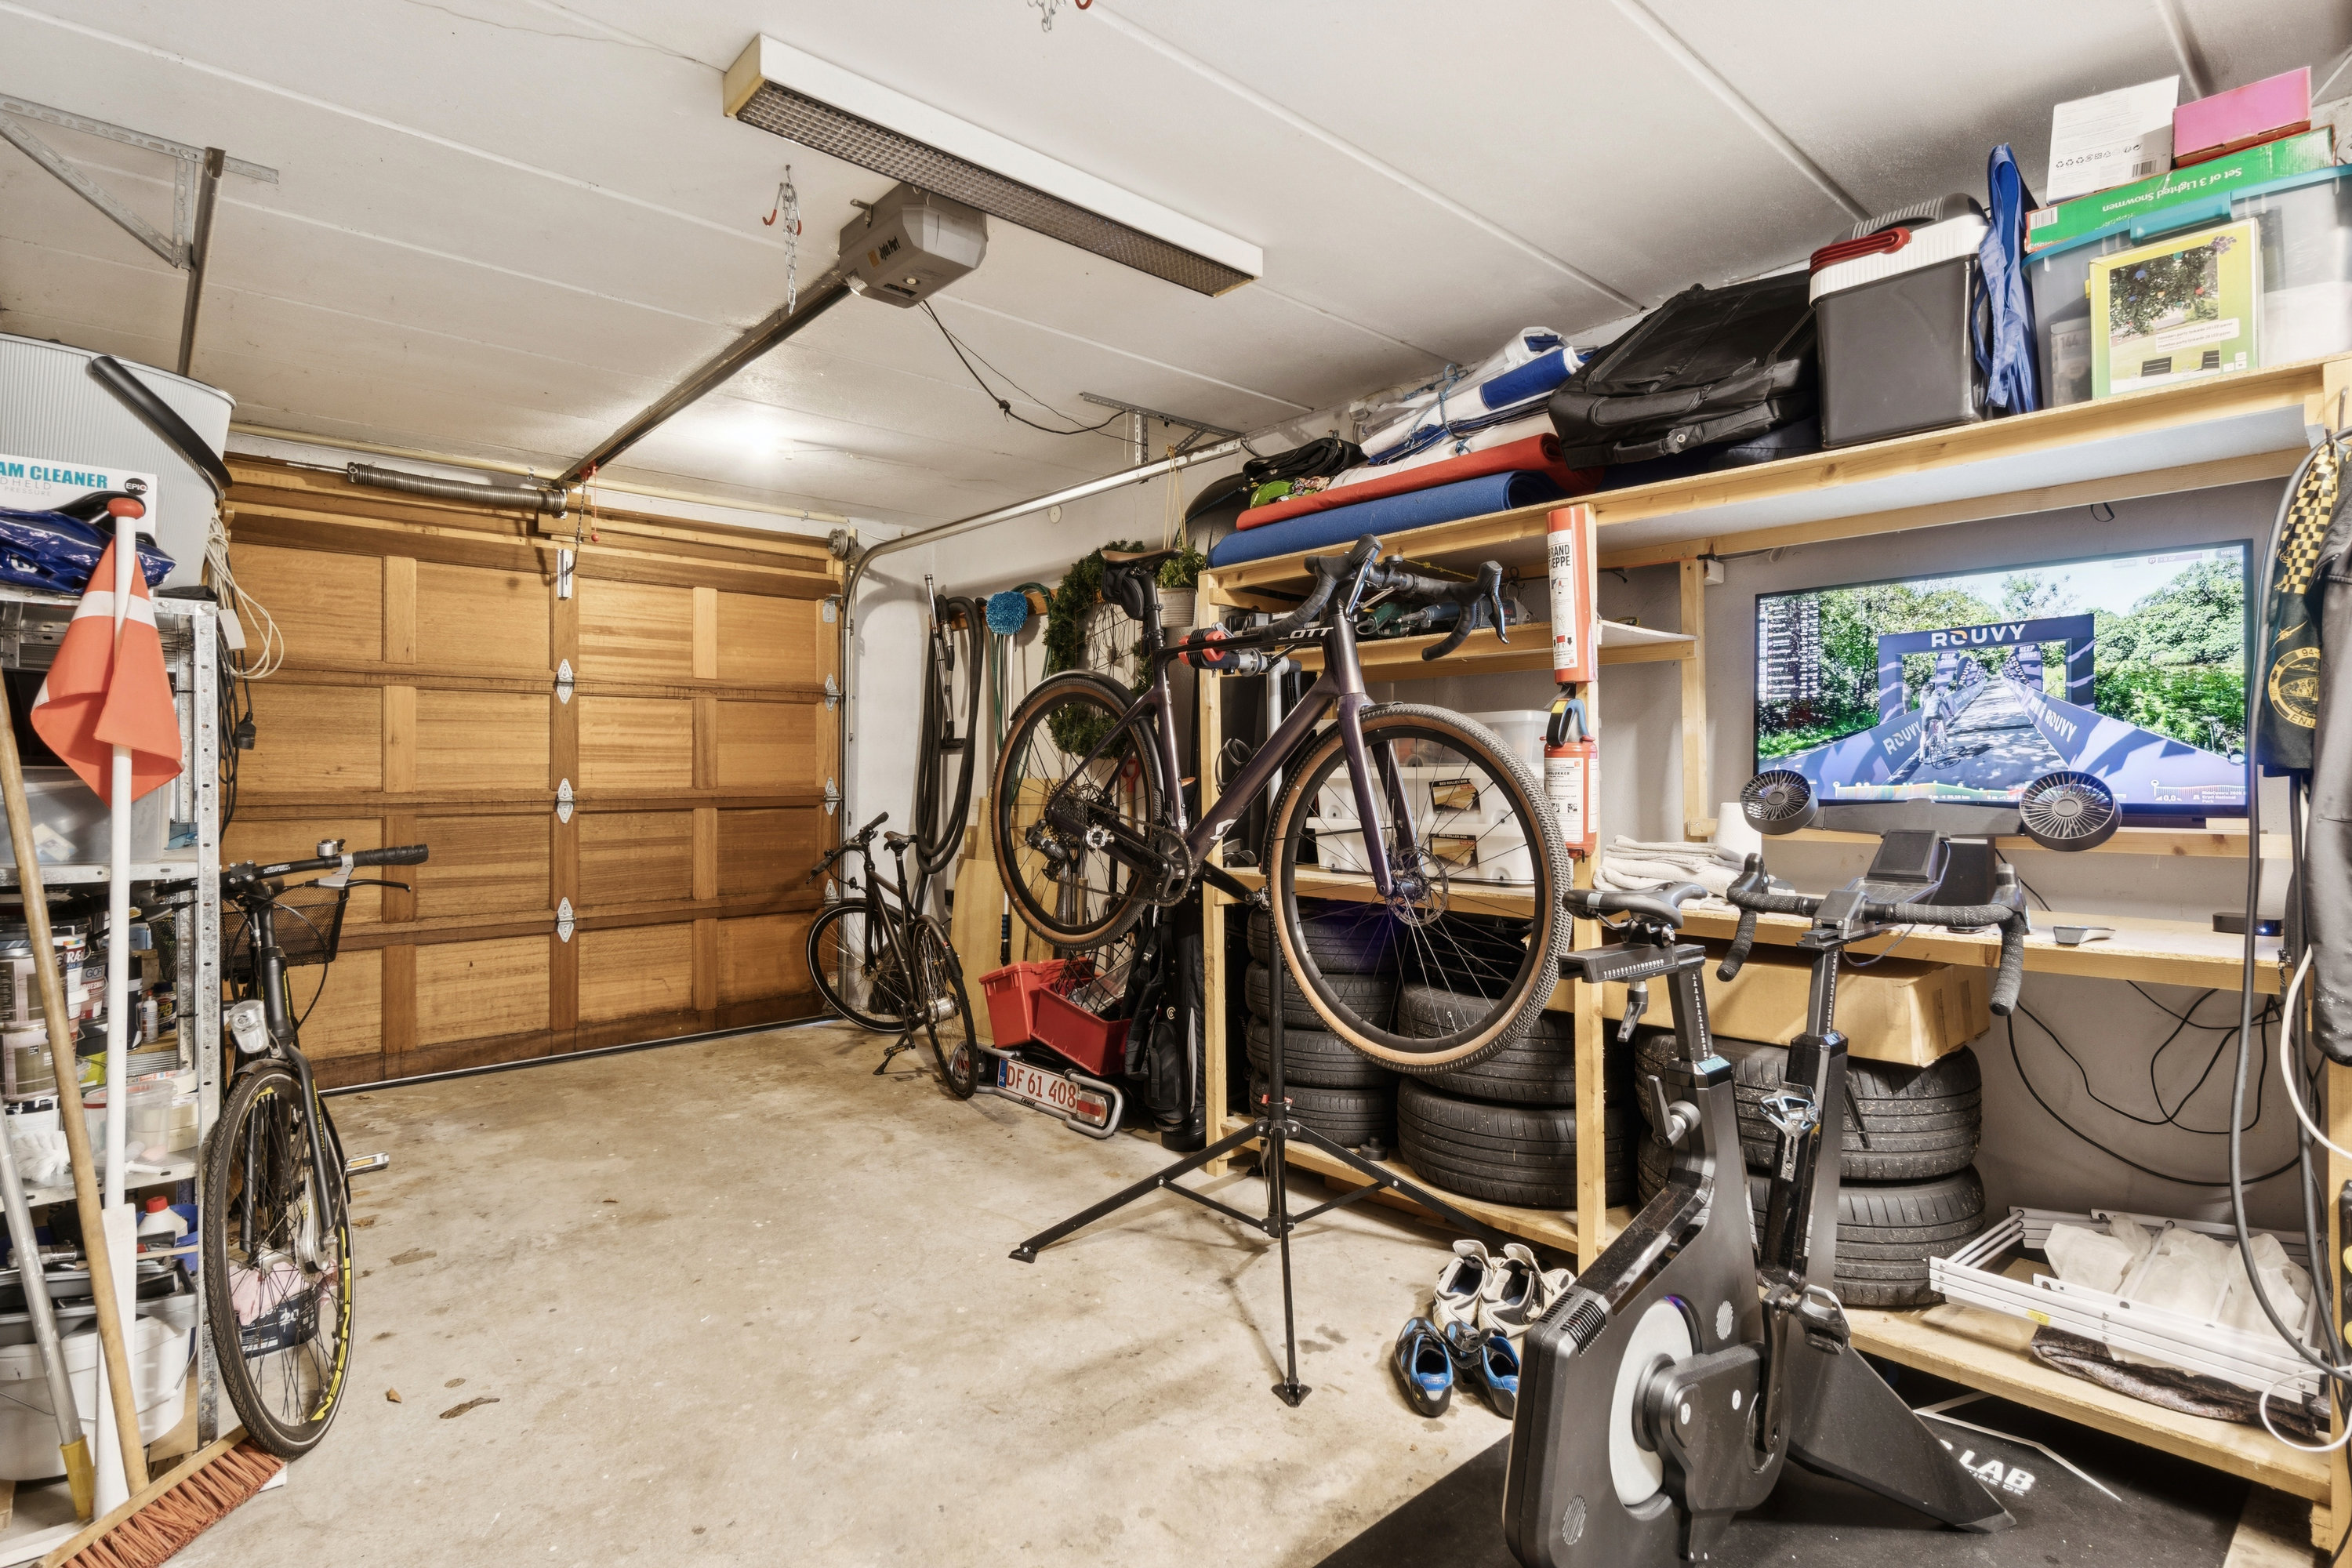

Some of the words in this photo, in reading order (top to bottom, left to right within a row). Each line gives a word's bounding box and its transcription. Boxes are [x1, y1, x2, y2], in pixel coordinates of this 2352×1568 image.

[2199, 177, 2207, 186] 3
[2209, 173, 2221, 184] of
[2224, 168, 2242, 179] Set
[2158, 180, 2196, 199] Lighted
[2102, 192, 2154, 212] Snowmen
[0, 477, 52, 490] DHELD
[30, 466, 108, 489] CLEANER
[1277, 627, 1334, 641] OTT
[1931, 624, 2026, 648] ROUVY
[2302, 648, 2321, 658] 94-
[2045, 709, 2078, 743] ROUVY
[1882, 720, 1922, 756] ROUVY
[1007, 1065, 1025, 1089] DF
[1028, 1073, 1043, 1098] 61
[1048, 1080, 1076, 1109] 408
[310, 1226, 351, 1421] JENSEN
[1959, 1450, 2035, 1490] LAB
[2002, 1483, 2026, 1496] DK
